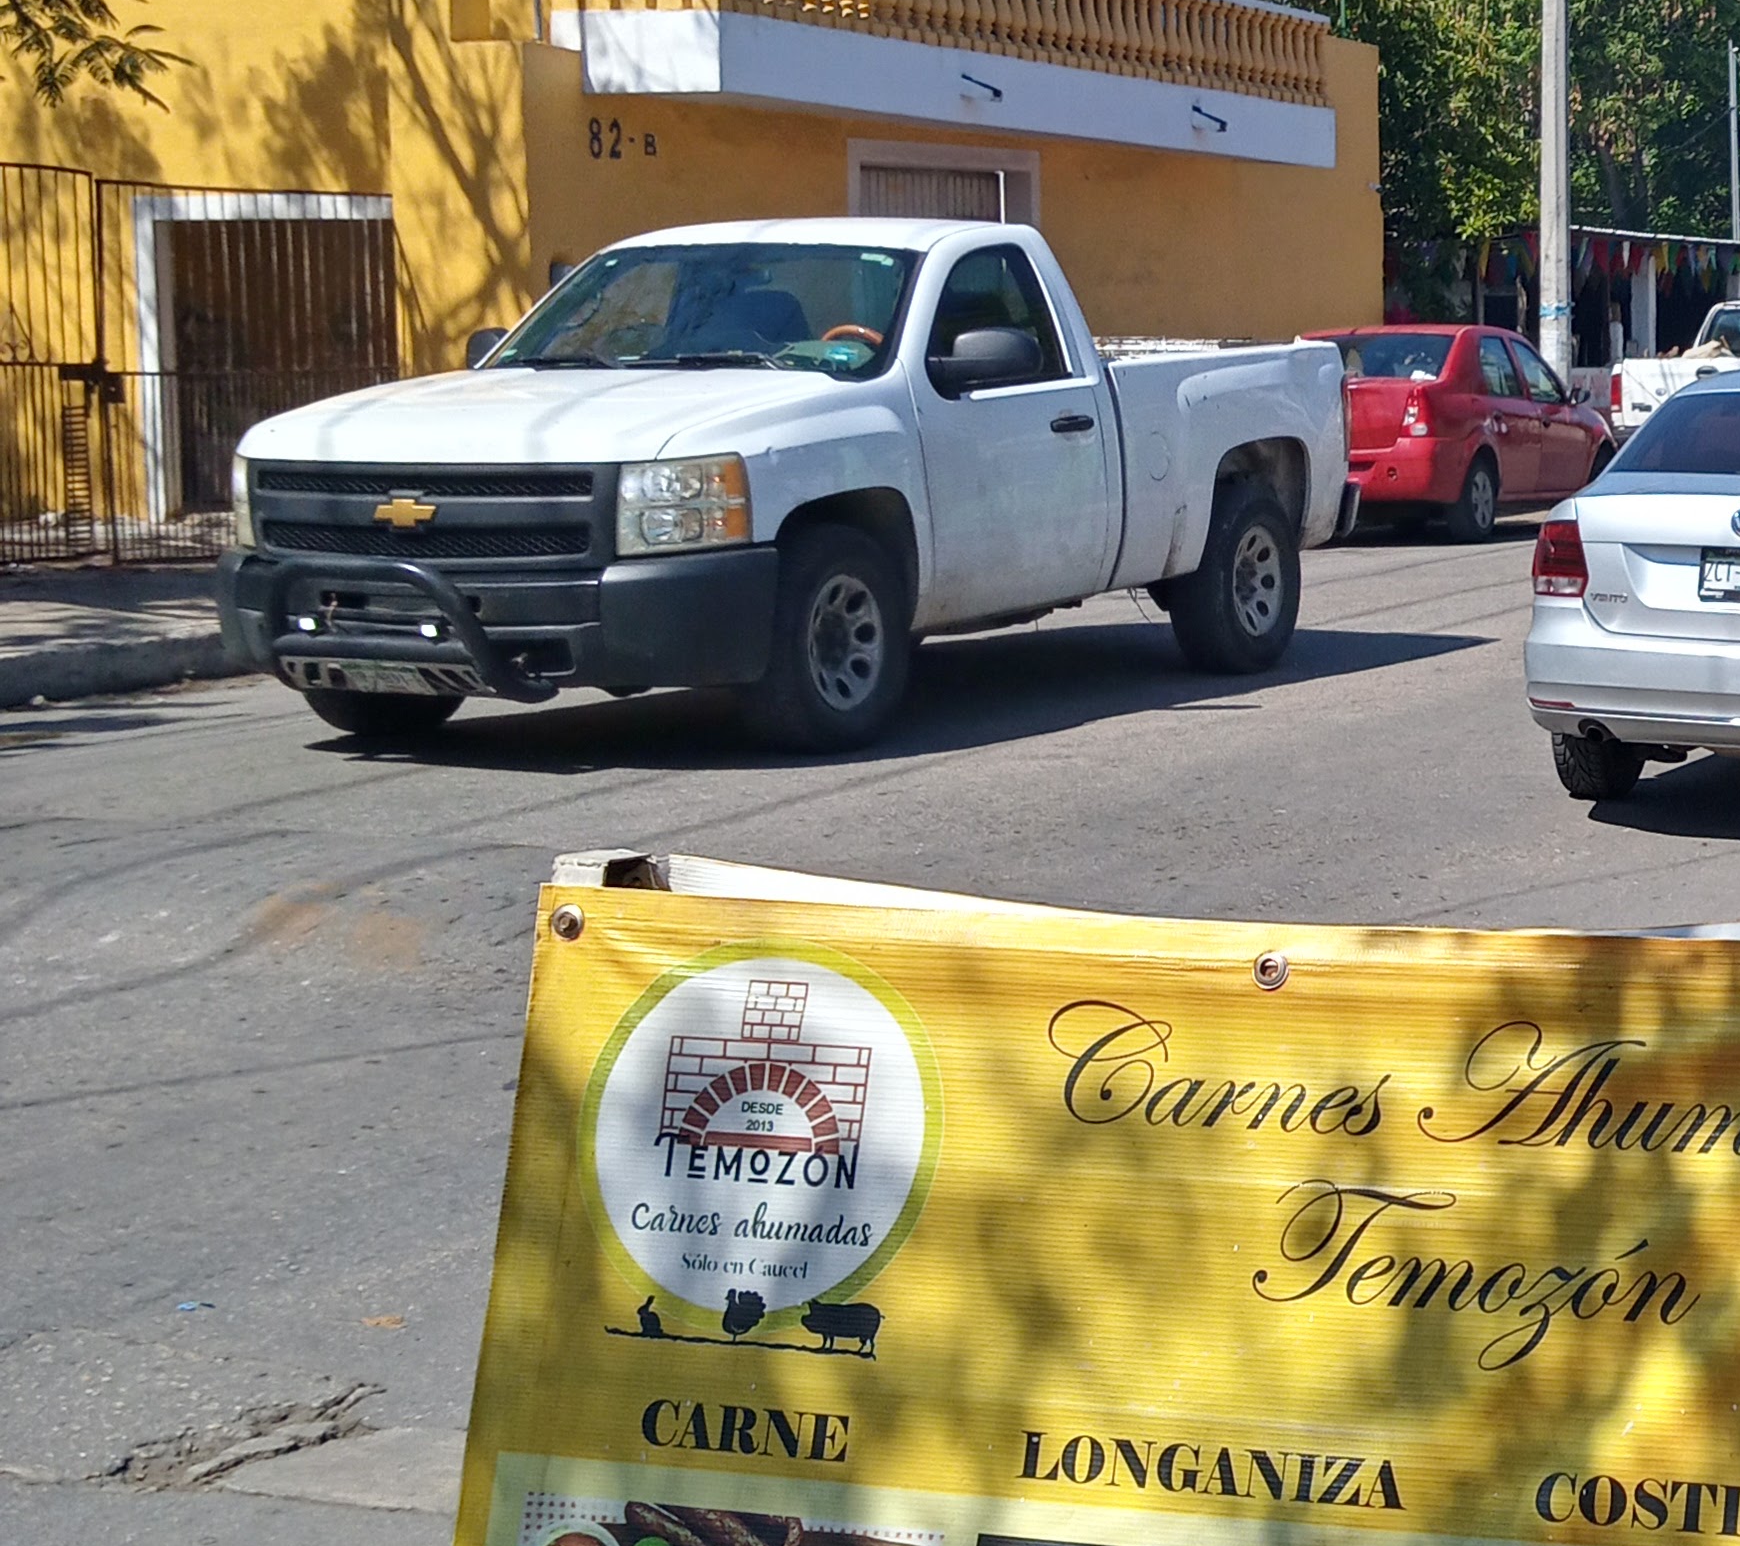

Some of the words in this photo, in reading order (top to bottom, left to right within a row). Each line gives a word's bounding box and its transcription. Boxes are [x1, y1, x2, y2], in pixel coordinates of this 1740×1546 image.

[1047, 1000, 1393, 1136] Carnes
[741, 1099, 784, 1116] DESDE
[746, 1118, 774, 1133] 2013
[631, 1202, 721, 1237] Carnes
[733, 1202, 873, 1247] ahumadas
[681, 1253, 718, 1273] Sólo
[722, 1260, 745, 1275] en
[1252, 1179, 1702, 1372] Temozón
[641, 1398, 849, 1463] CARNE
[1016, 1428, 1406, 1512] LONGANIZA
